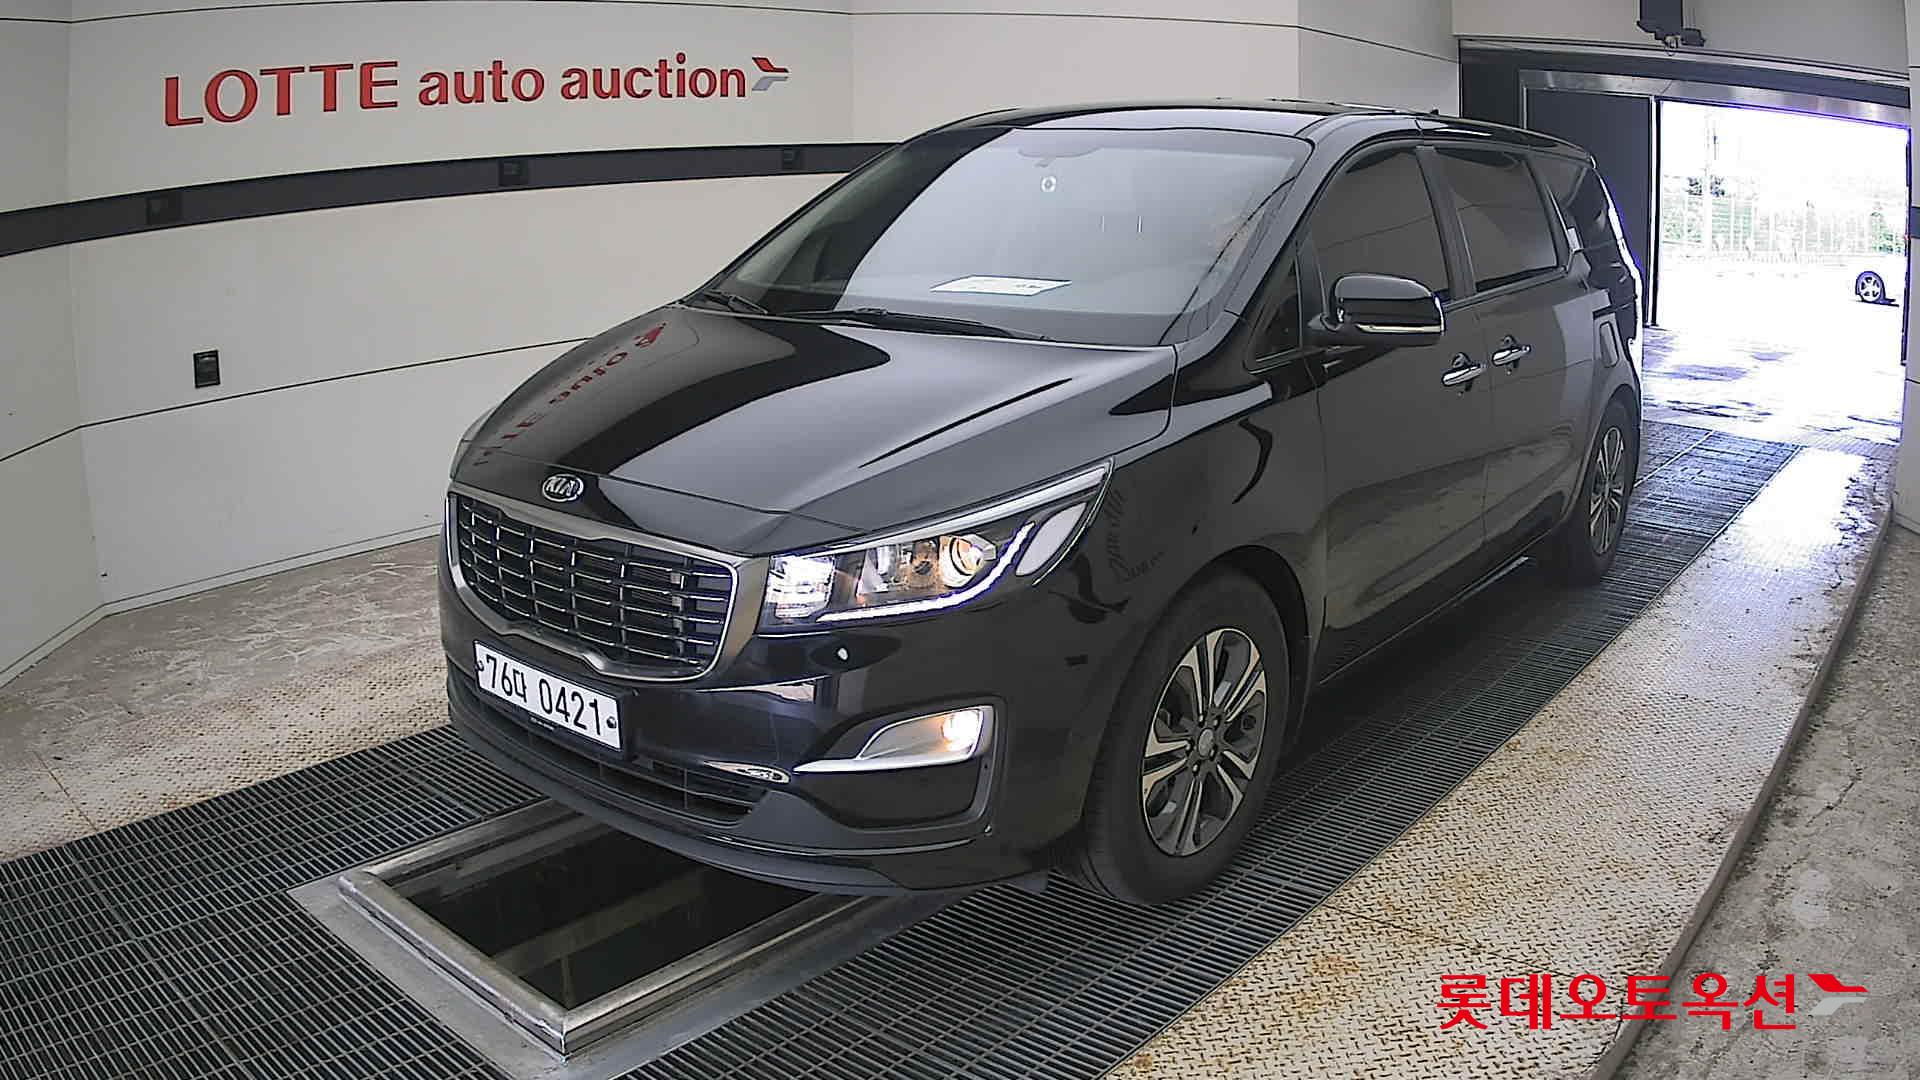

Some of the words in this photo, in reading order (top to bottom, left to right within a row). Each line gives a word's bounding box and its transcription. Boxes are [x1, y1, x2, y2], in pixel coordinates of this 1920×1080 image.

[164, 60, 399, 127] LOTTE
[418, 60, 545, 106] auto
[560, 53, 748, 103] auction
[545, 477, 576, 497] KIA
[485, 653, 528, 704] 76다
[538, 677, 602, 736] 0421
